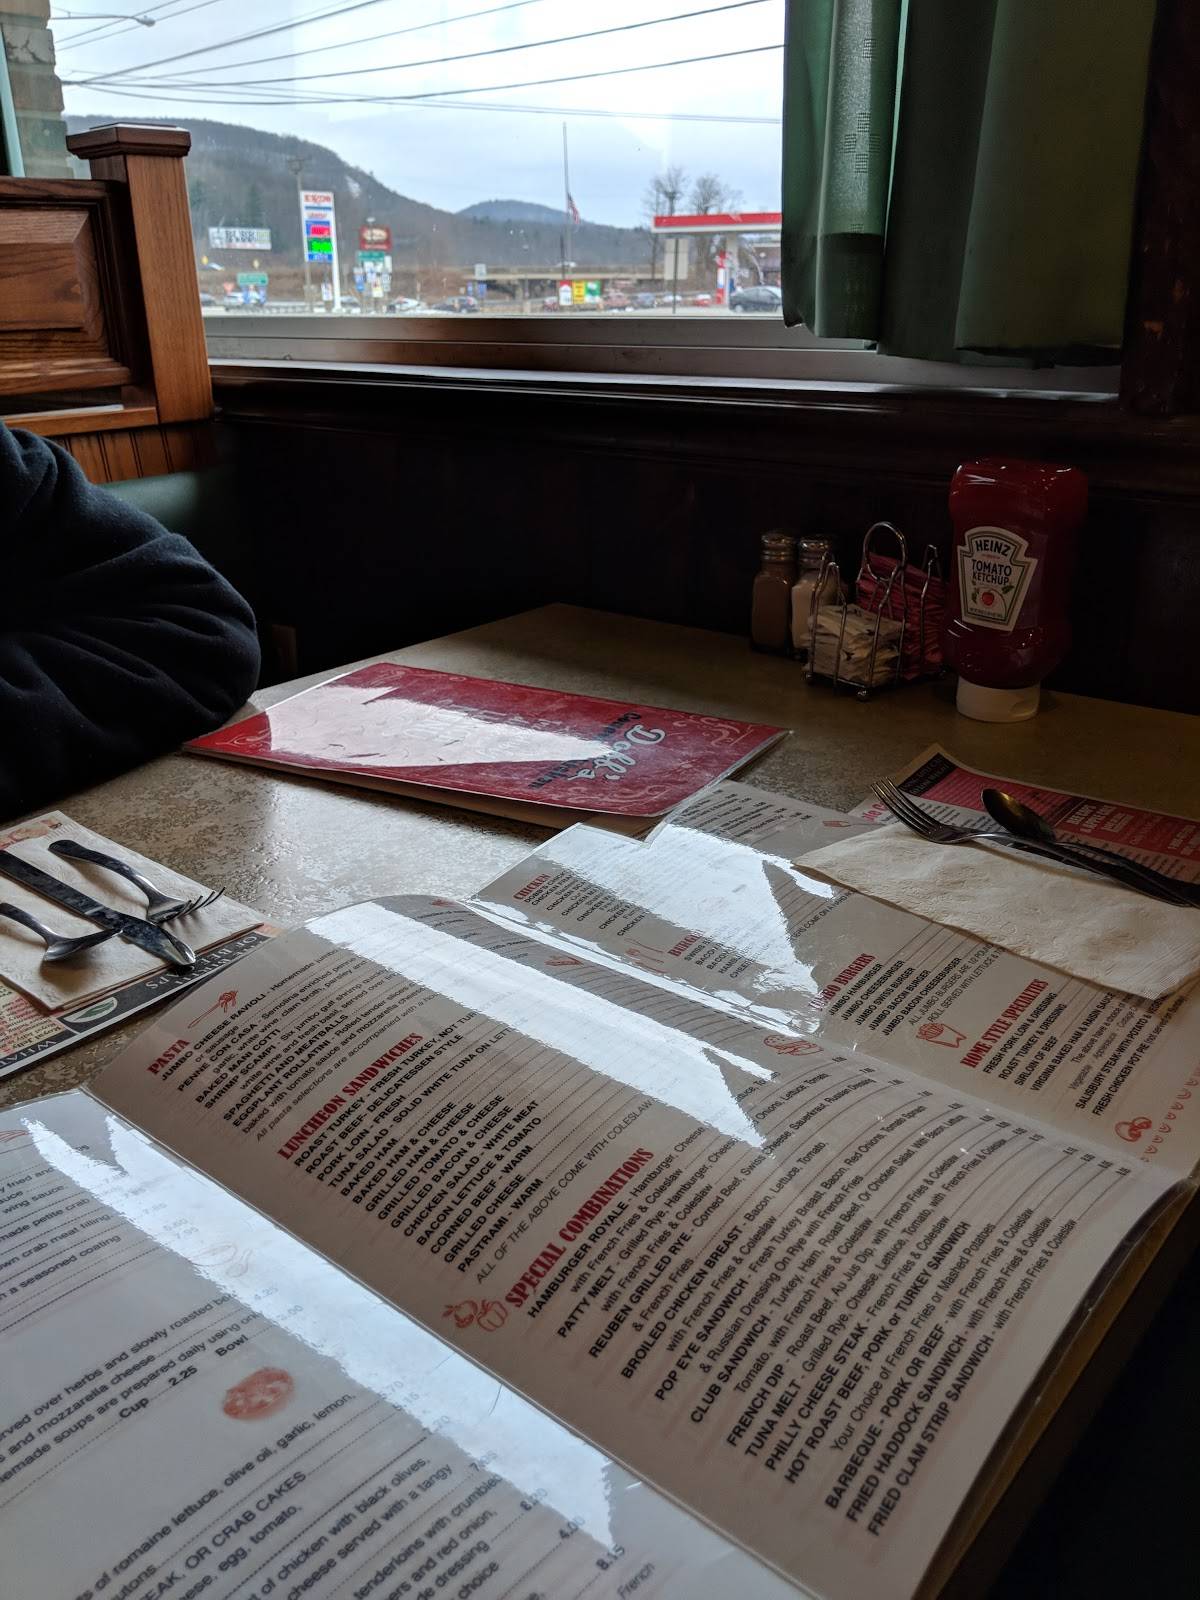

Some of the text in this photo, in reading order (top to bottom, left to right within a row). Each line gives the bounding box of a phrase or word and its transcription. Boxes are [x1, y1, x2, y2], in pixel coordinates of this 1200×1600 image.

[971, 559, 1012, 577] TOMATO
[972, 572, 1009, 586] KETCHUP
[975, 540, 1011, 556] HEINZ
[511, 869, 552, 903] CHICKEN
[826, 960, 883, 1017] JUMBO HAMBURGER
[839, 957, 905, 1021] JUMBO CHEESEBURGER
[880, 954, 961, 1037] JUMBO BACON CHEESEBURGER
[959, 974, 1048, 1071] HOME STYLE SPECIALTIES
[981, 1051, 1004, 1075] FRESH
[998, 1033, 1019, 1055] PORK
[1028, 990, 1058, 1020] DRESSING
[145, 1033, 191, 1078] PASTA
[159, 991, 268, 1081] JUMBO CHEESE RAVIOLI
[175, 1019, 259, 1092] PENNE CON CASA
[221, 1010, 349, 1123] SPAGHETTI AND MEATBALLS
[997, 1056, 1021, 1081] ROAST
[1015, 1033, 1040, 1060] TURKEY
[1012, 1058, 1039, 1088] SIRLOIN
[1041, 1033, 1059, 1052] BEEF
[1029, 989, 1115, 1093] VIRGINIA BAKED HAM RAISIN SAUCE
[1073, 1072, 1106, 1110] SALISBURY
[1127, 1016, 1149, 1040] POTATO
[1091, 1040, 1150, 1116] FRESH CHICKEN POT PIE
[231, 1037, 332, 1128] EGGPLANT ROLLATINI
[276, 1028, 424, 1161] LUNCHEON SANDWICHES
[293, 1130, 330, 1167] ROAST
[326, 1094, 367, 1133] TURKEY
[368, 1063, 403, 1094] FRESH
[436, 1020, 458, 1038] NOT
[304, 1137, 341, 1175] ROAST
[365, 1052, 436, 1113] DELICATESSEN
[431, 1031, 464, 1057] STYLE
[351, 1098, 456, 1205] BAKED HAM CHEESE
[375, 1092, 506, 1222] GRILLED TOMATO CHEESE
[401, 1098, 540, 1238] CHICKEN SALAD WHITE MEAT
[415, 1114, 543, 1246] BACON LETTUCE TOMATO
[17, 1229, 123, 1291] seasoned coating
[502, 1142, 653, 1310] SPECIAL COMBINATIONS
[525, 1198, 629, 1319] HAMBURGER ROYALE
[555, 1263, 617, 1339] PATTY MELT
[586, 1229, 692, 1359] REUBEN GRILLED RYE
[618, 1223, 745, 1380] BROILED CHICKEN BREAST
[652, 1275, 749, 1402] POP EYE SANDWICH
[31, 1299, 214, 1417] over herbs and slowly roasted
[166, 1363, 199, 1388] 2.25
[213, 1331, 250, 1358] Bowl
[688, 1312, 770, 1425] CLUB SANDWICH
[783, 1447, 813, 1483] HOT
[805, 1398, 844, 1450] ROAST
[835, 1359, 870, 1402] BEEF,
[861, 1324, 893, 1363] PORK
[894, 1268, 933, 1313] TURKEY
[35, 1350, 157, 1437] mozzarella cheese
[116, 1393, 152, 1423] Cup
[725, 1361, 788, 1448] FRENCH DIP
[744, 1378, 803, 1459] TUNA MELT
[764, 1321, 869, 1471] PHILLY CHEESE STEAK
[824, 1423, 883, 1510] BARBEQUE
[879, 1376, 912, 1418] PORK
[917, 1321, 947, 1358] BEEF
[844, 1333, 968, 1523] FRIED HADDOCK SANDWICH
[865, 1332, 995, 1536] FRIED CLAM STRIP SANDWICH
[109, 1522, 174, 1576] romaine
[220, 1457, 257, 1490] olive
[209, 1506, 258, 1550] CRAB
[254, 1467, 308, 1515] CAKES
[284, 1462, 457, 1600] cheese served with tangy
[617, 1561, 656, 1600] French
